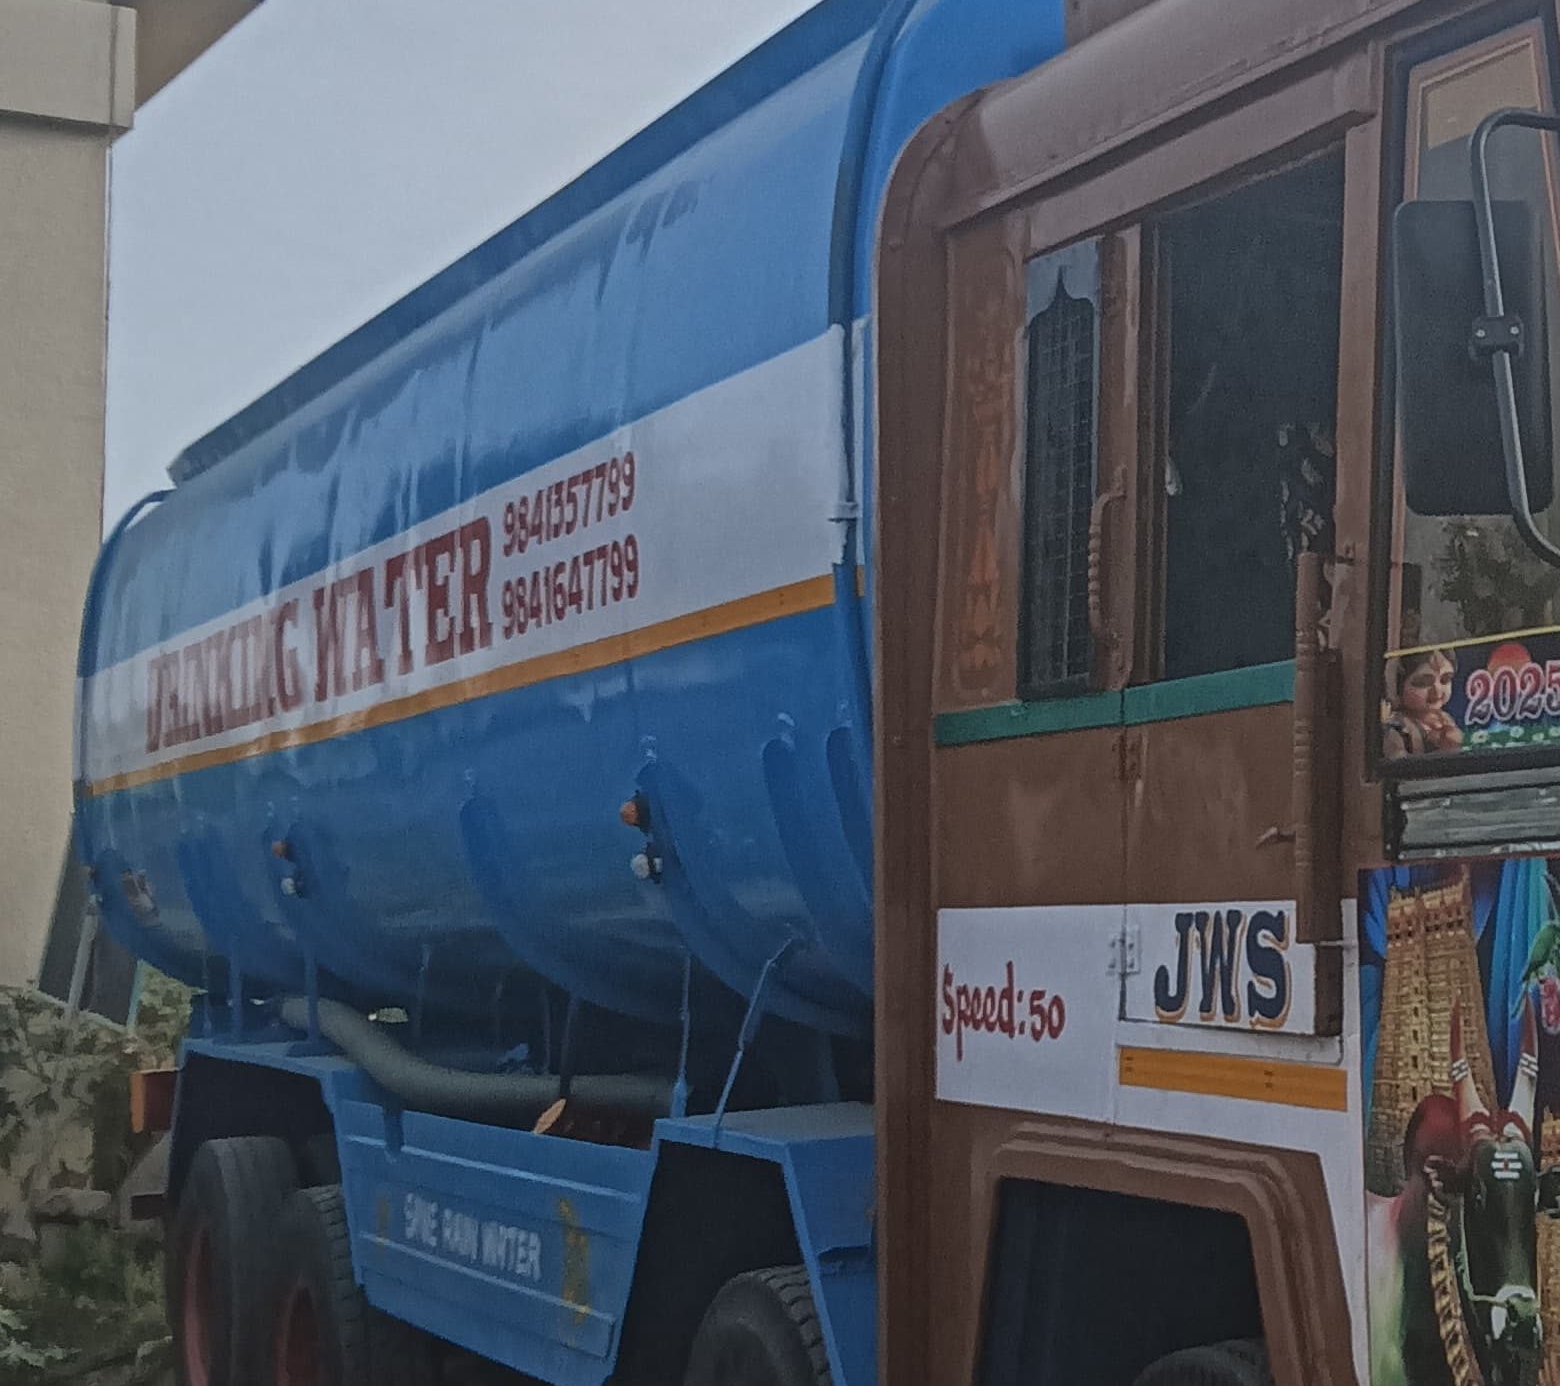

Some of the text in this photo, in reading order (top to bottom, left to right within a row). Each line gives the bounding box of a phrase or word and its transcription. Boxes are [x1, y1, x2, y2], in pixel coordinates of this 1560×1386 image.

[502, 450, 636, 557] 9841357799
[312, 516, 494, 703] WATER
[501, 534, 640, 639] 9841647799
[942, 961, 1066, 1062] Speed:50
[1153, 909, 1292, 1027] JWS
